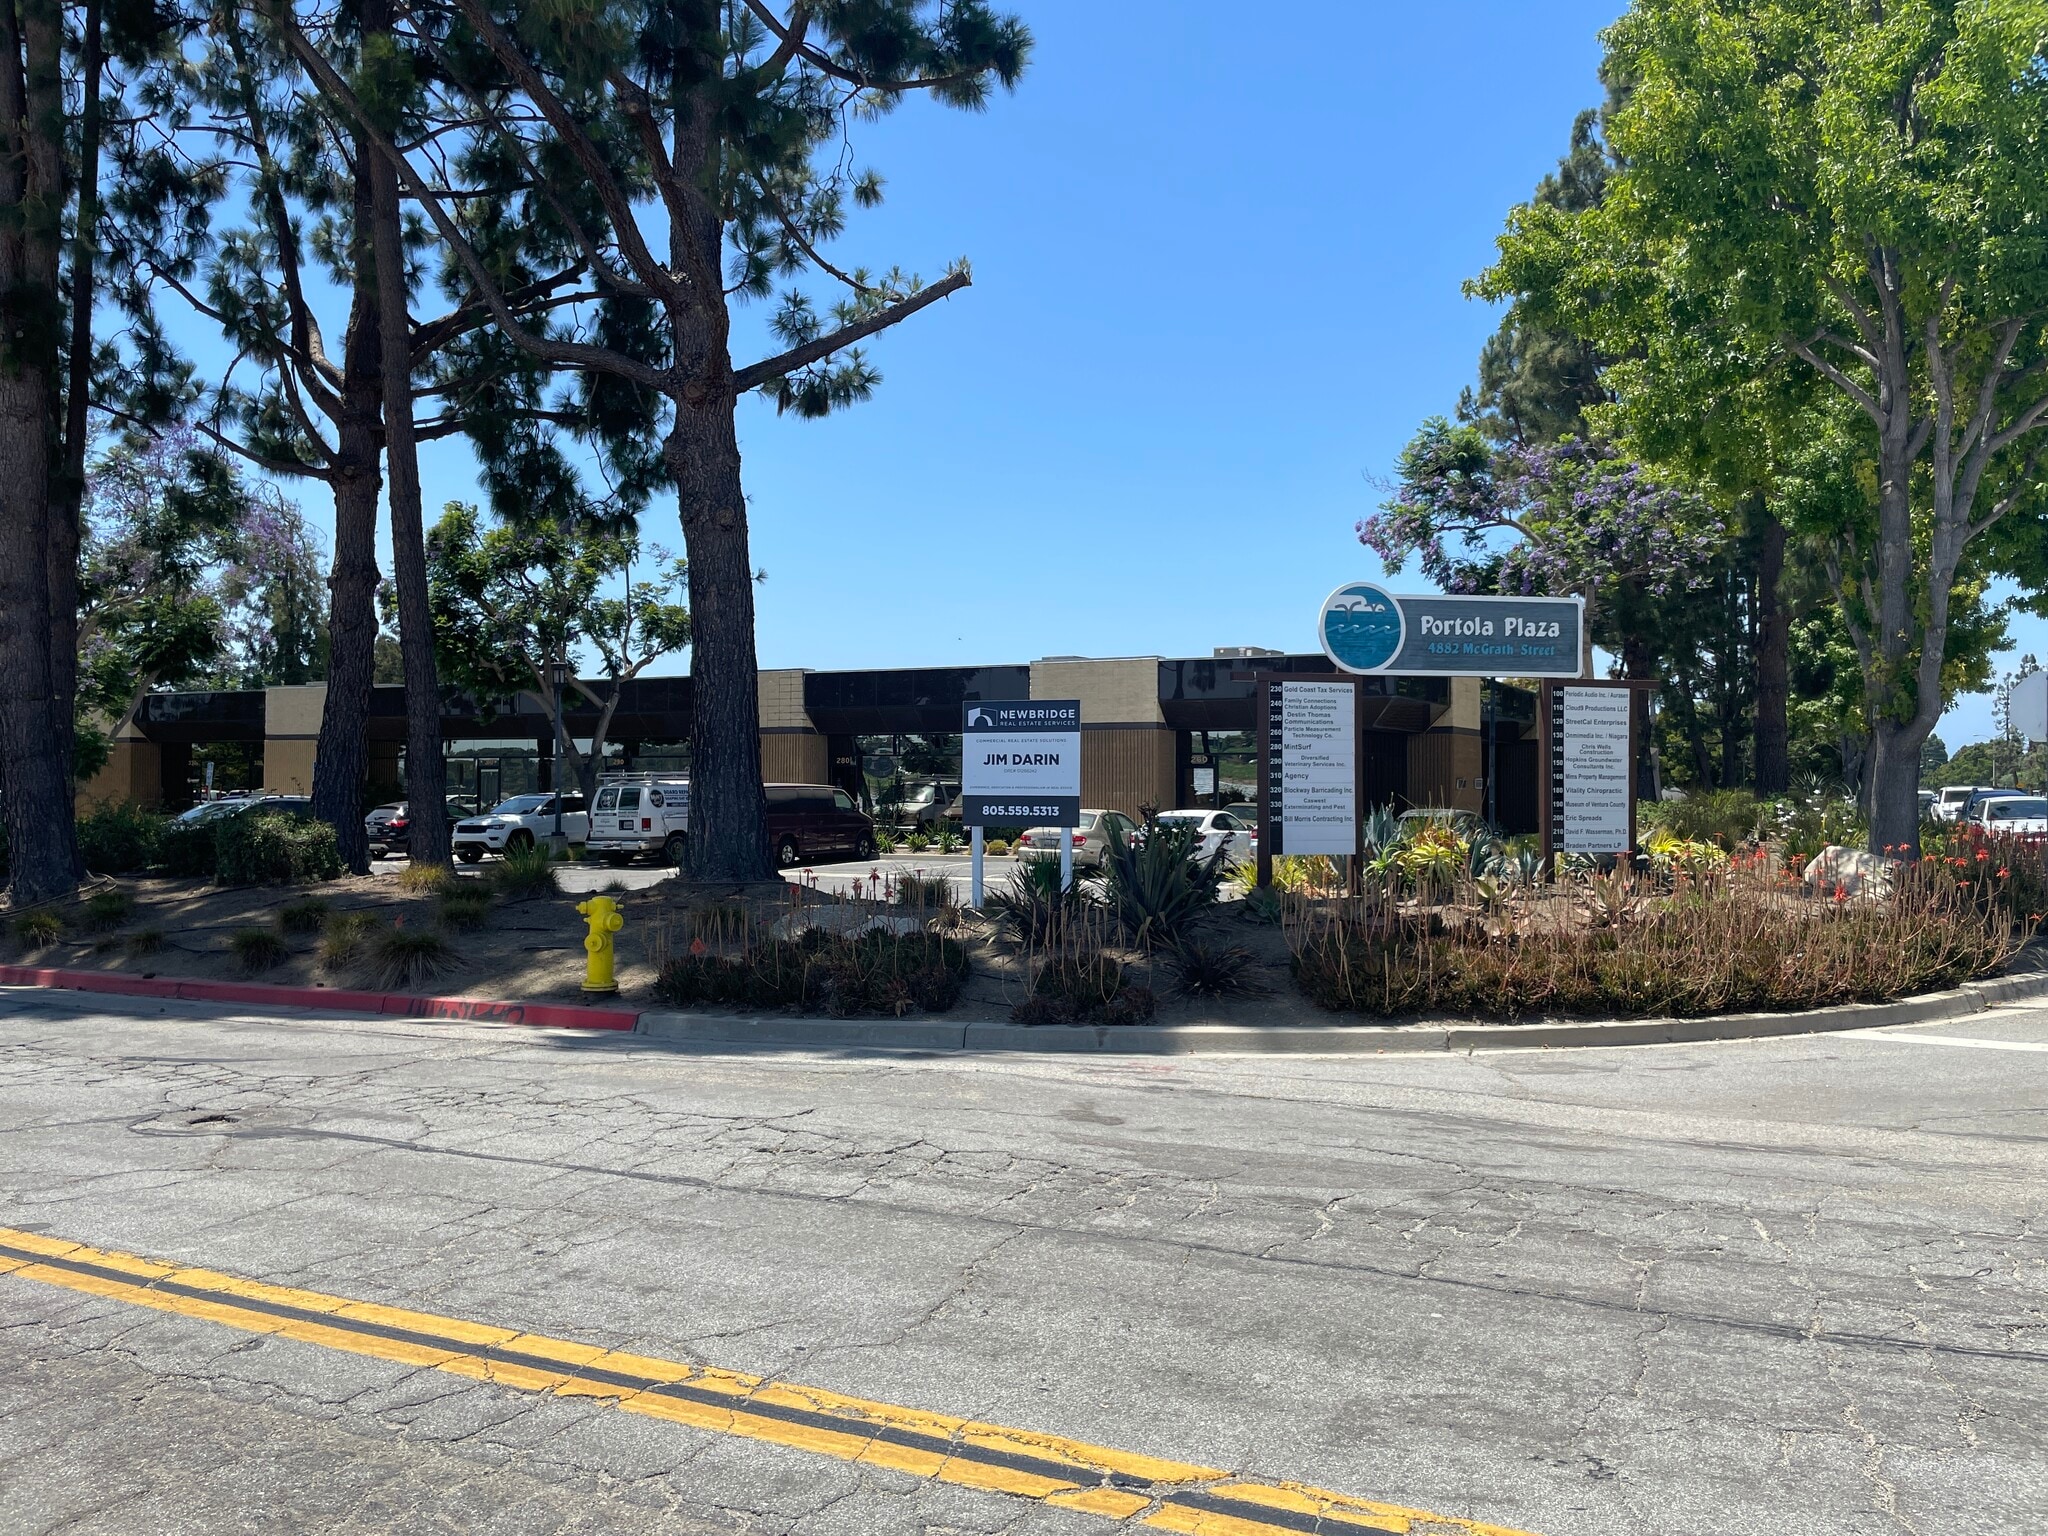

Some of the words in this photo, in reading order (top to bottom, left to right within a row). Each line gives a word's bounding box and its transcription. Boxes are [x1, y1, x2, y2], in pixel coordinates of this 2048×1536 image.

[1420, 616, 1494, 636] Portola
[1504, 617, 1560, 638] Plaza
[1428, 642, 1459, 654] 4882
[1463, 643, 1514, 656] McGrath
[1520, 644, 1555, 656] Street
[1000, 709, 1076, 720] NEWBRIDGE
[983, 754, 1008, 766] JIM
[1012, 754, 1060, 766] DARIN
[1284, 786, 1310, 794] Blockway
[982, 805, 1060, 816] 805.559.5313
